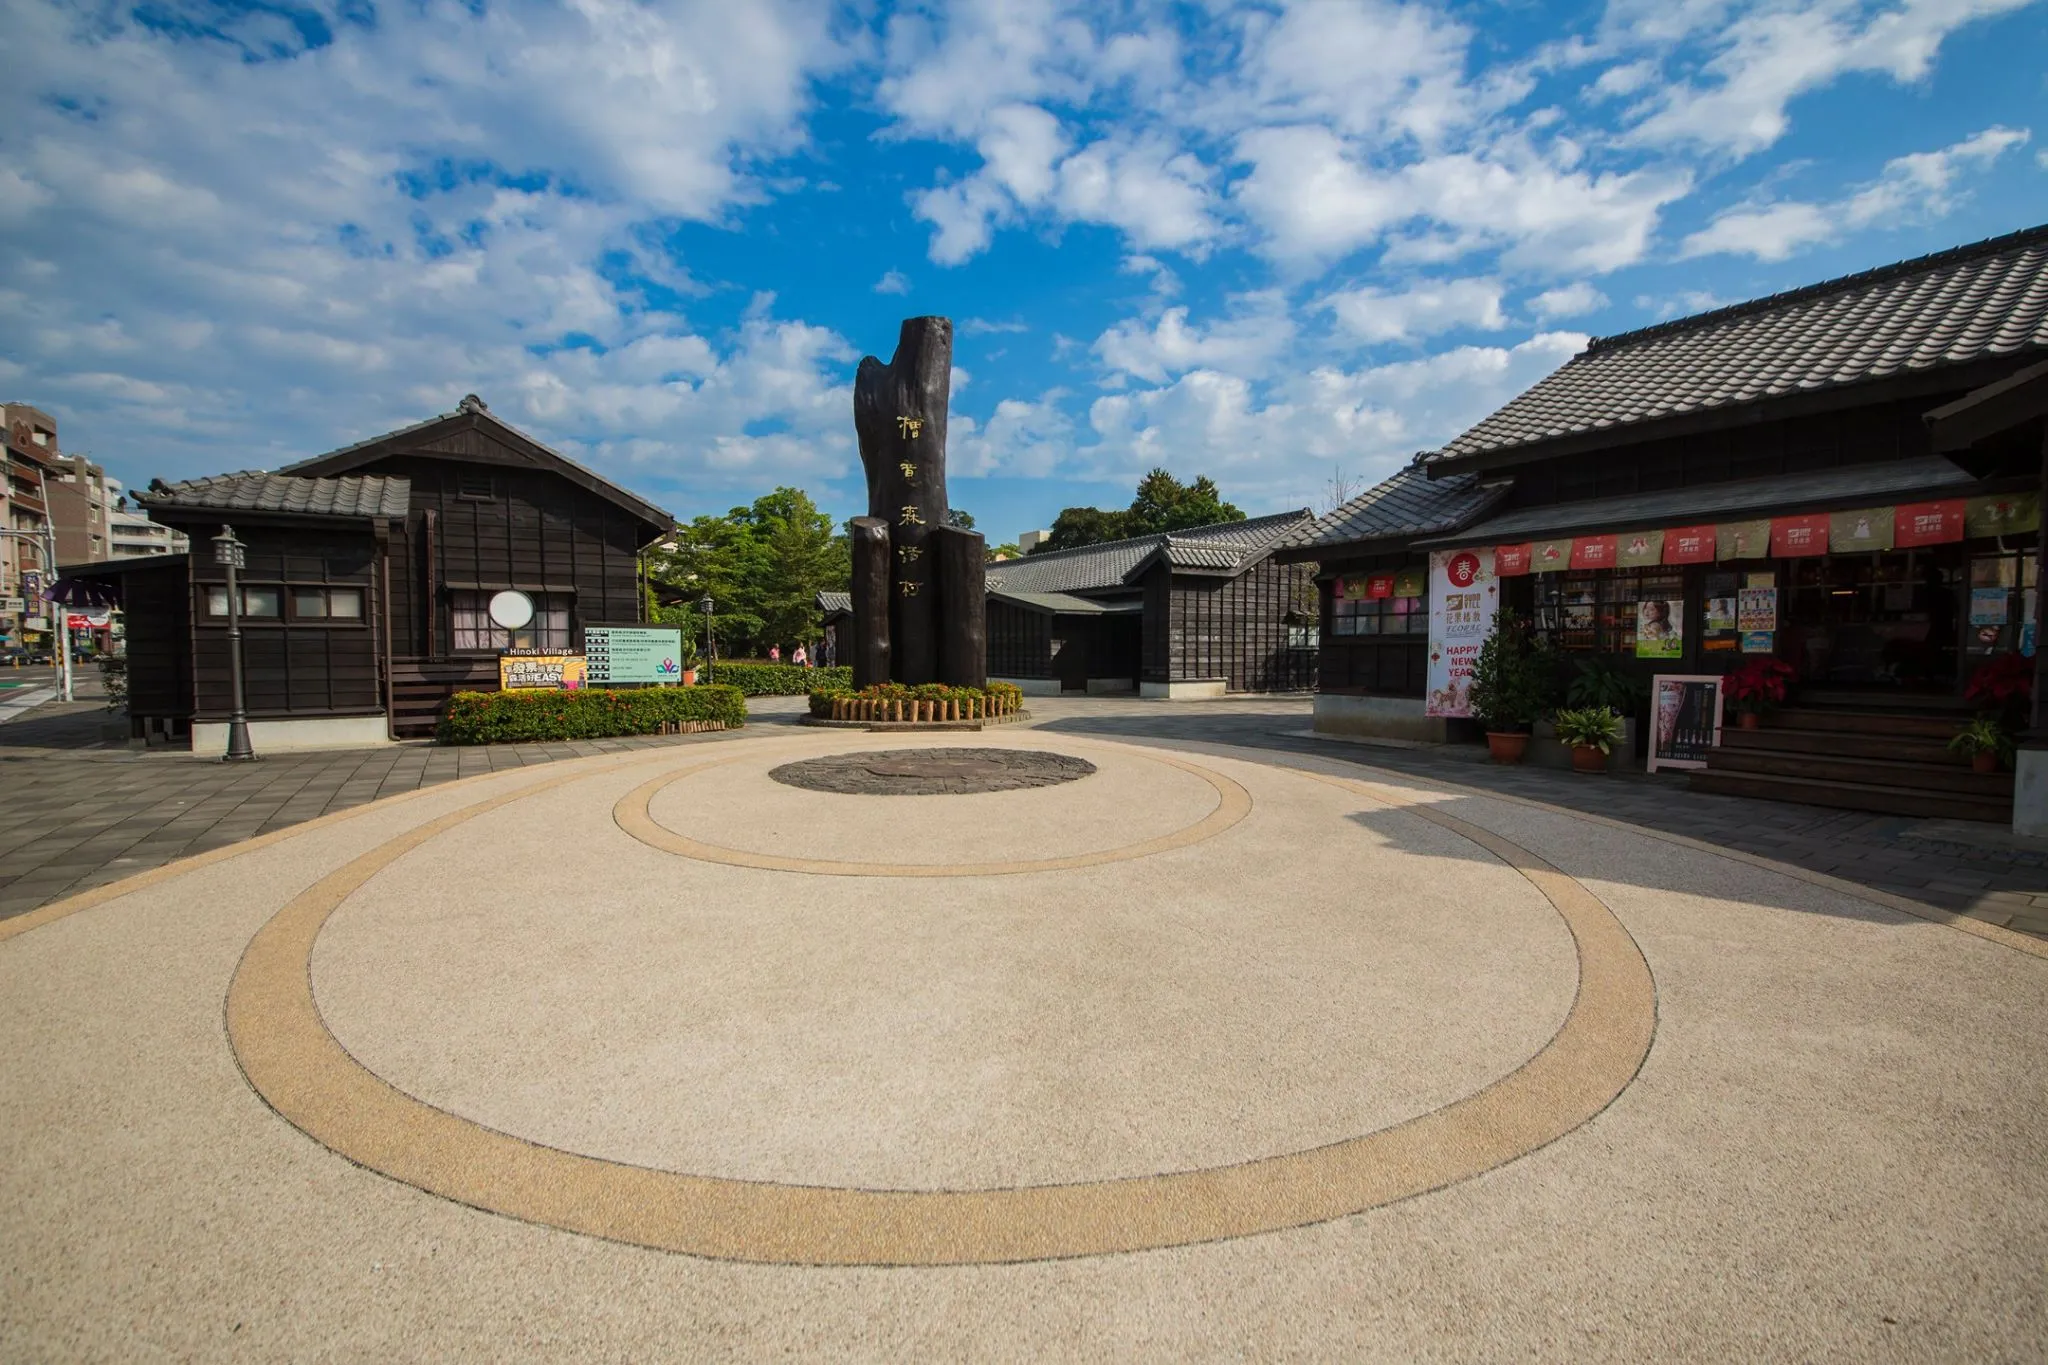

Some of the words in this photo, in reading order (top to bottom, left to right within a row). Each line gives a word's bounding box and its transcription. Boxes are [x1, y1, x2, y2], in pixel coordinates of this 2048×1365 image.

[1456, 560, 1472, 580] 春
[542, 648, 574, 656] Village
[1446, 645, 1478, 655] HAPPY
[1451, 657, 1475, 666] NEW
